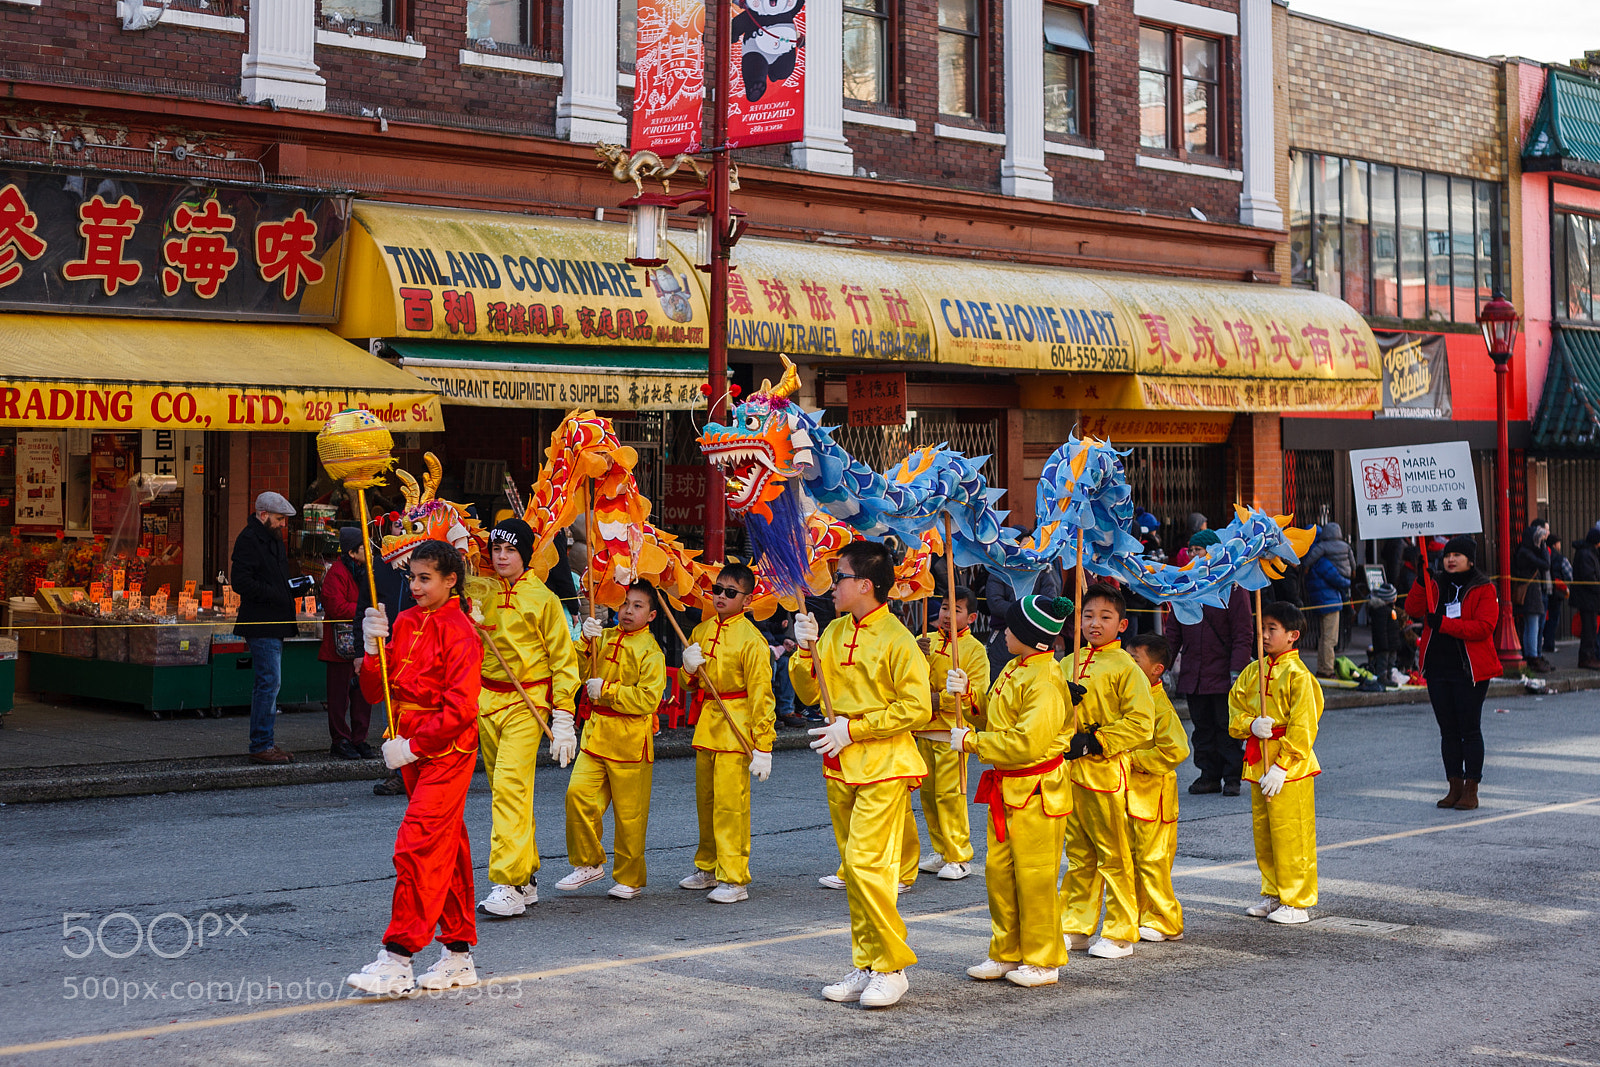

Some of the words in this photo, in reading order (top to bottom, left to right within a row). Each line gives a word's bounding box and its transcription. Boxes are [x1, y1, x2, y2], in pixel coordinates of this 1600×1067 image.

[383, 245, 501, 290] TINLAND
[503, 253, 643, 299] COOKWARE
[399, 287, 478, 335] 百利
[940, 298, 1003, 341] CARE
[1000, 301, 1066, 344] HOME
[1060, 308, 1121, 347] MART
[788, 323, 842, 353] TRAVEL
[1050, 344, 1129, 370] 604-559-2822
[1384, 336, 1423, 375] Vegan
[493, 380, 557, 402] EQUIPMENT
[559, 383, 567, 402] &
[569, 384, 619, 403] SUPPLIES
[1142, 382, 1168, 406] DONG
[1169, 383, 1198, 407] CHENG
[1200, 384, 1239, 407] TRADING
[1390, 364, 1431, 405] Supply
[151, 391, 212, 428] CO.,
[227, 394, 291, 425] LTD.
[306, 401, 333, 422] 262
[412, 402, 434, 423] St.
[1145, 421, 1170, 435] DONG
[1170, 422, 1197, 435] CHENG
[1402, 456, 1437, 469] MARIA
[1404, 469, 1437, 482] MIMIE
[1439, 468, 1456, 480] HO
[1406, 482, 1466, 494] FOUNDATION
[1366, 497, 1468, 517] 何李美薇基金會
[1401, 520, 1435, 530] Presents
